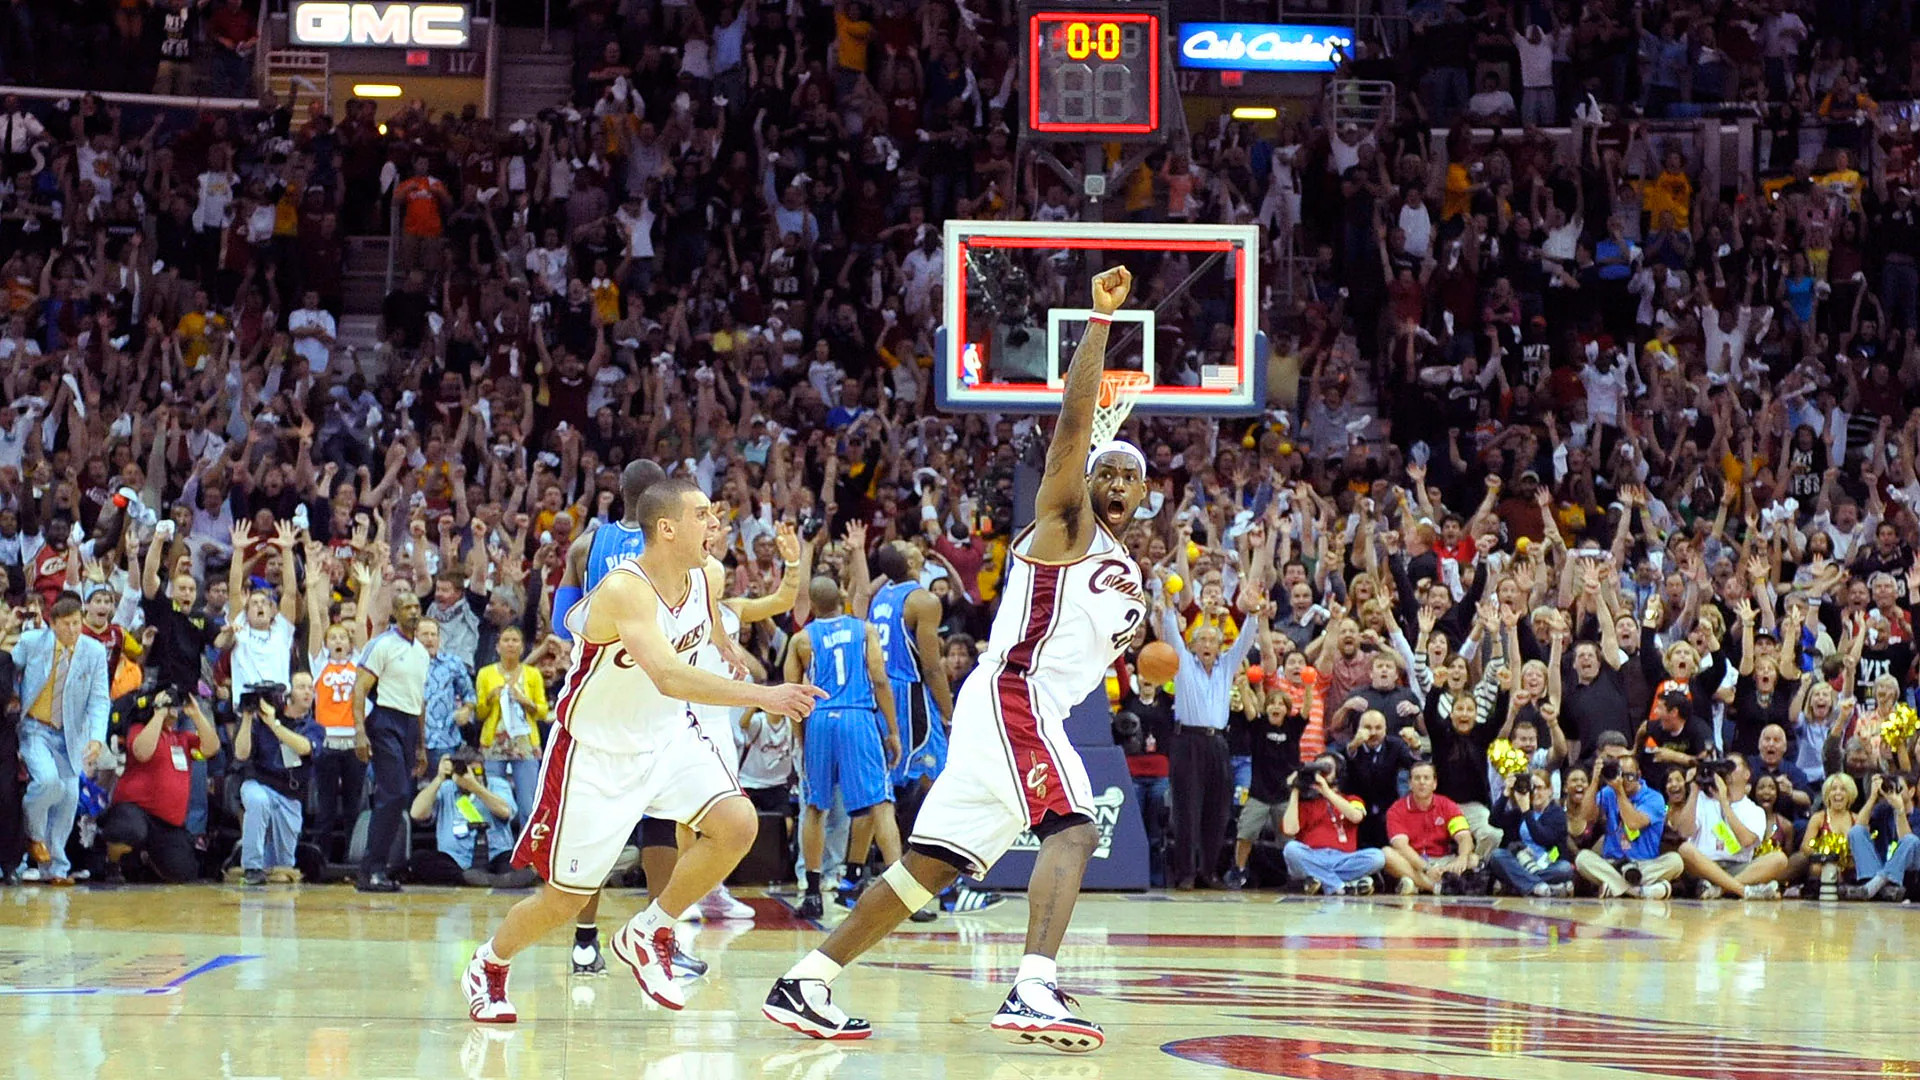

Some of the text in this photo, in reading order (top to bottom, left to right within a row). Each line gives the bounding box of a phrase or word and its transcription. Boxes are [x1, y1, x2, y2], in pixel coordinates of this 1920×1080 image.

[296, 3, 467, 45] GMC
[1183, 31, 1245, 60] Cub
[833, 647, 846, 686] 1
